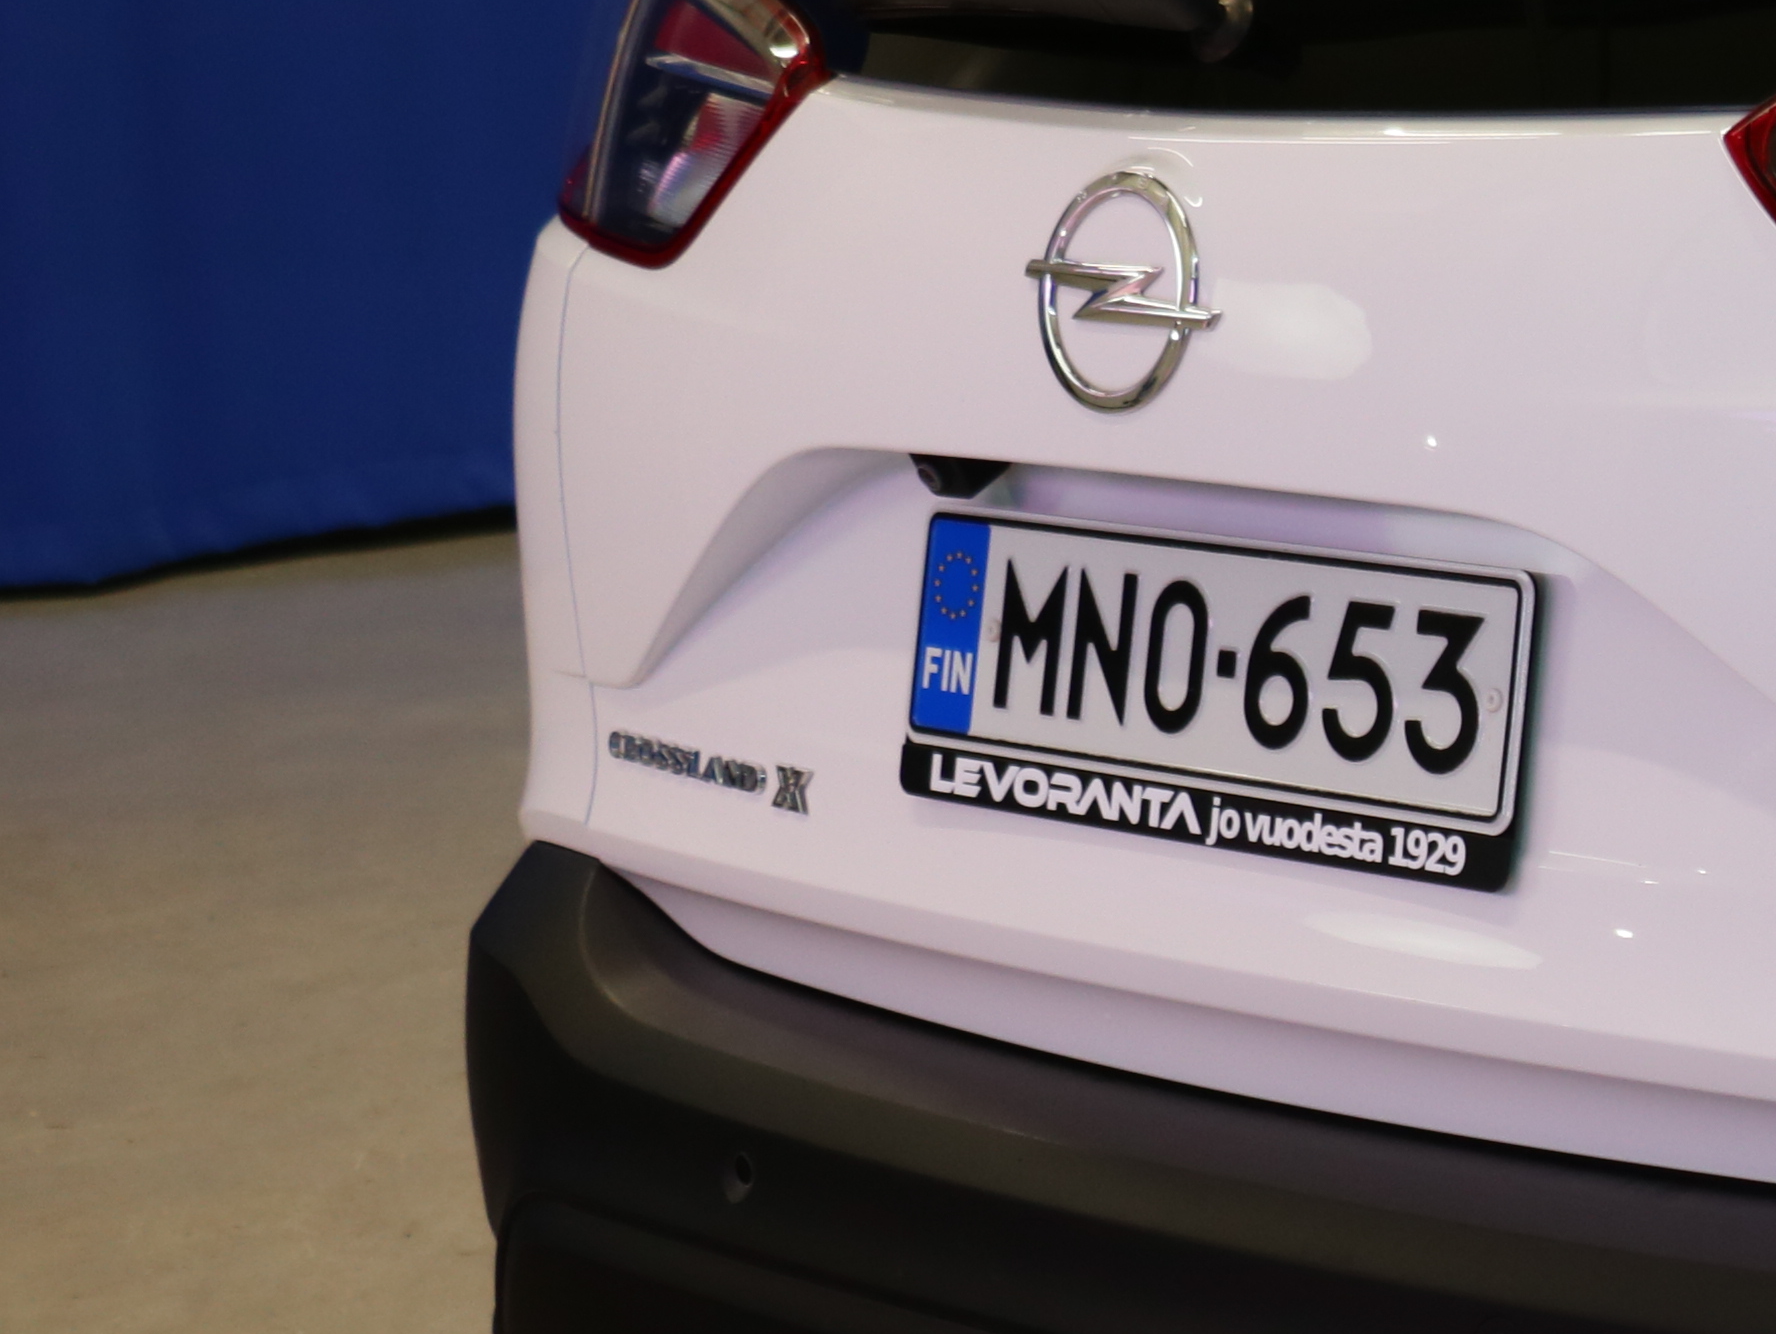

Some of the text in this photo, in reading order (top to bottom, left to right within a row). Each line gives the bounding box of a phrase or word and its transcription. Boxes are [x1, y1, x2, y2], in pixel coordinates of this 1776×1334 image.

[921, 645, 974, 696] FIN
[993, 557, 1487, 775] MNO-653
[771, 764, 814, 816] X
[929, 753, 1467, 876] LEVORANTA jo vuodesta 1929
